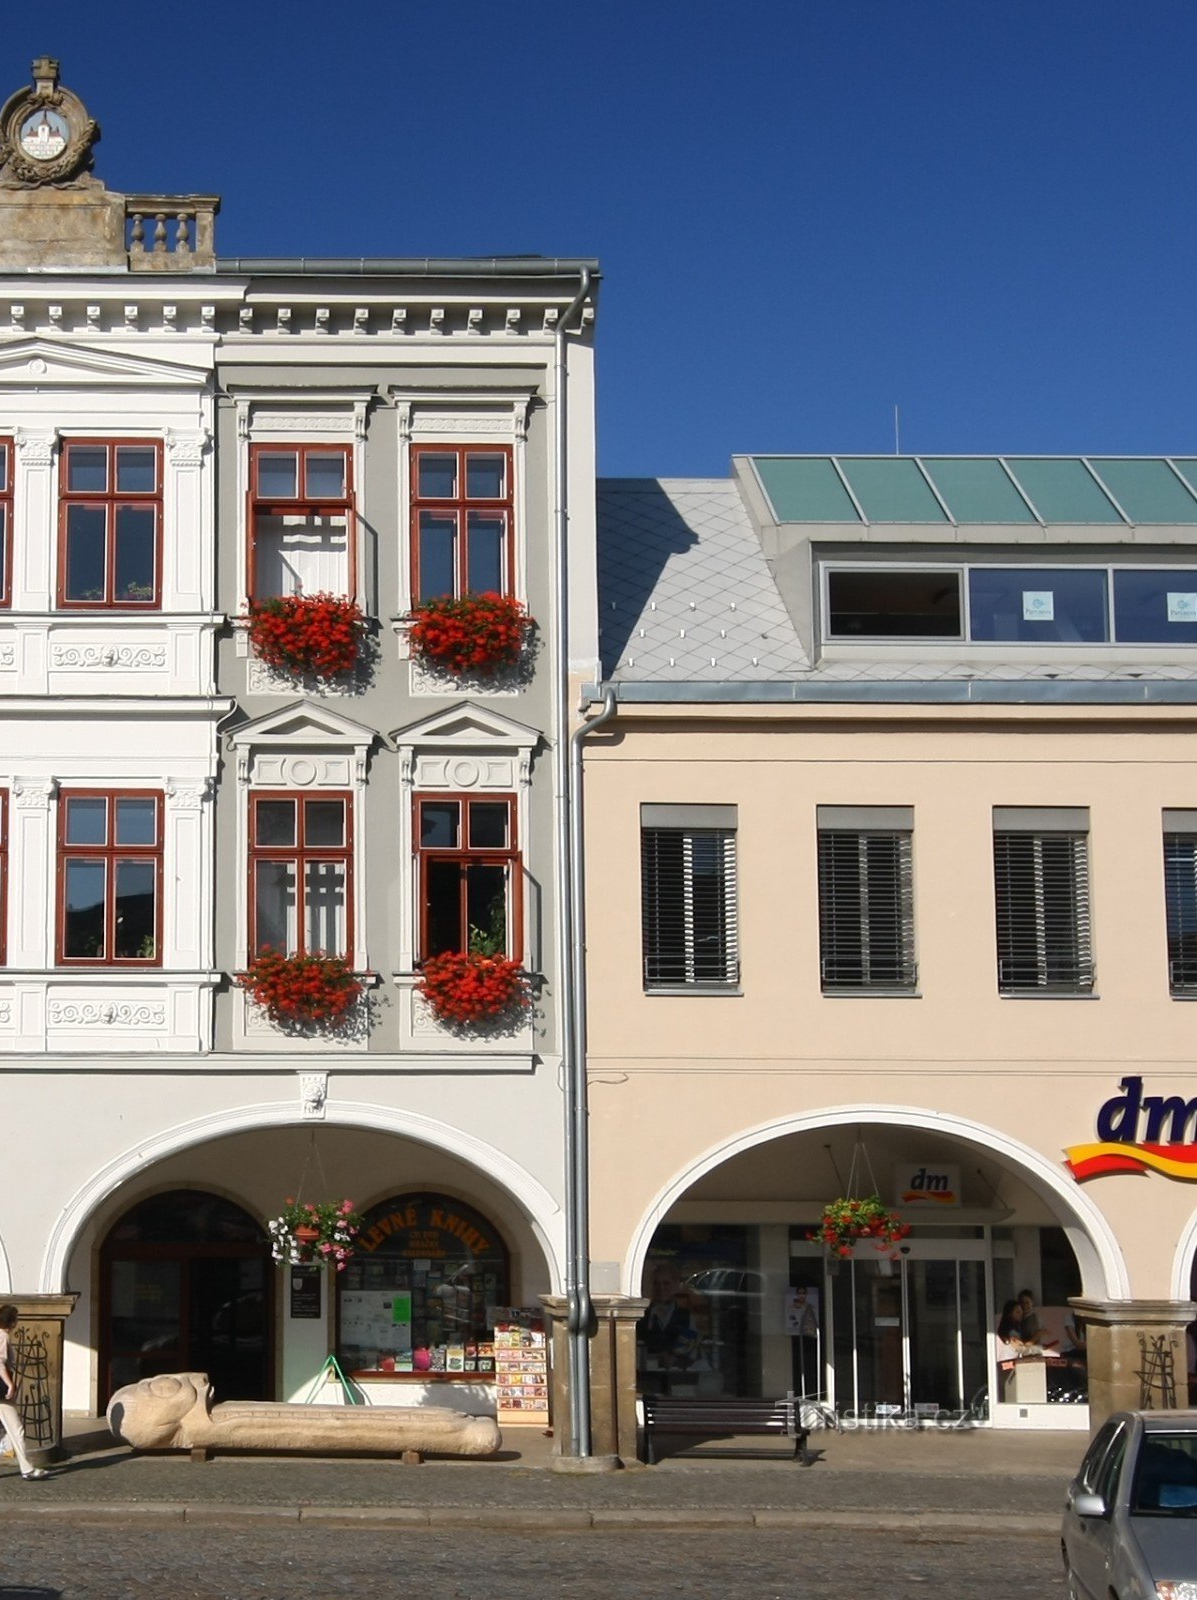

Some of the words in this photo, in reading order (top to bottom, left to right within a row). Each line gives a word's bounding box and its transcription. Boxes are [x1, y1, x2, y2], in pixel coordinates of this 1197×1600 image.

[1096, 1075, 1197, 1143] dm
[910, 1167, 949, 1191] dm
[358, 1203, 419, 1253] LEVNÉ
[429, 1208, 491, 1255] KNIHY
